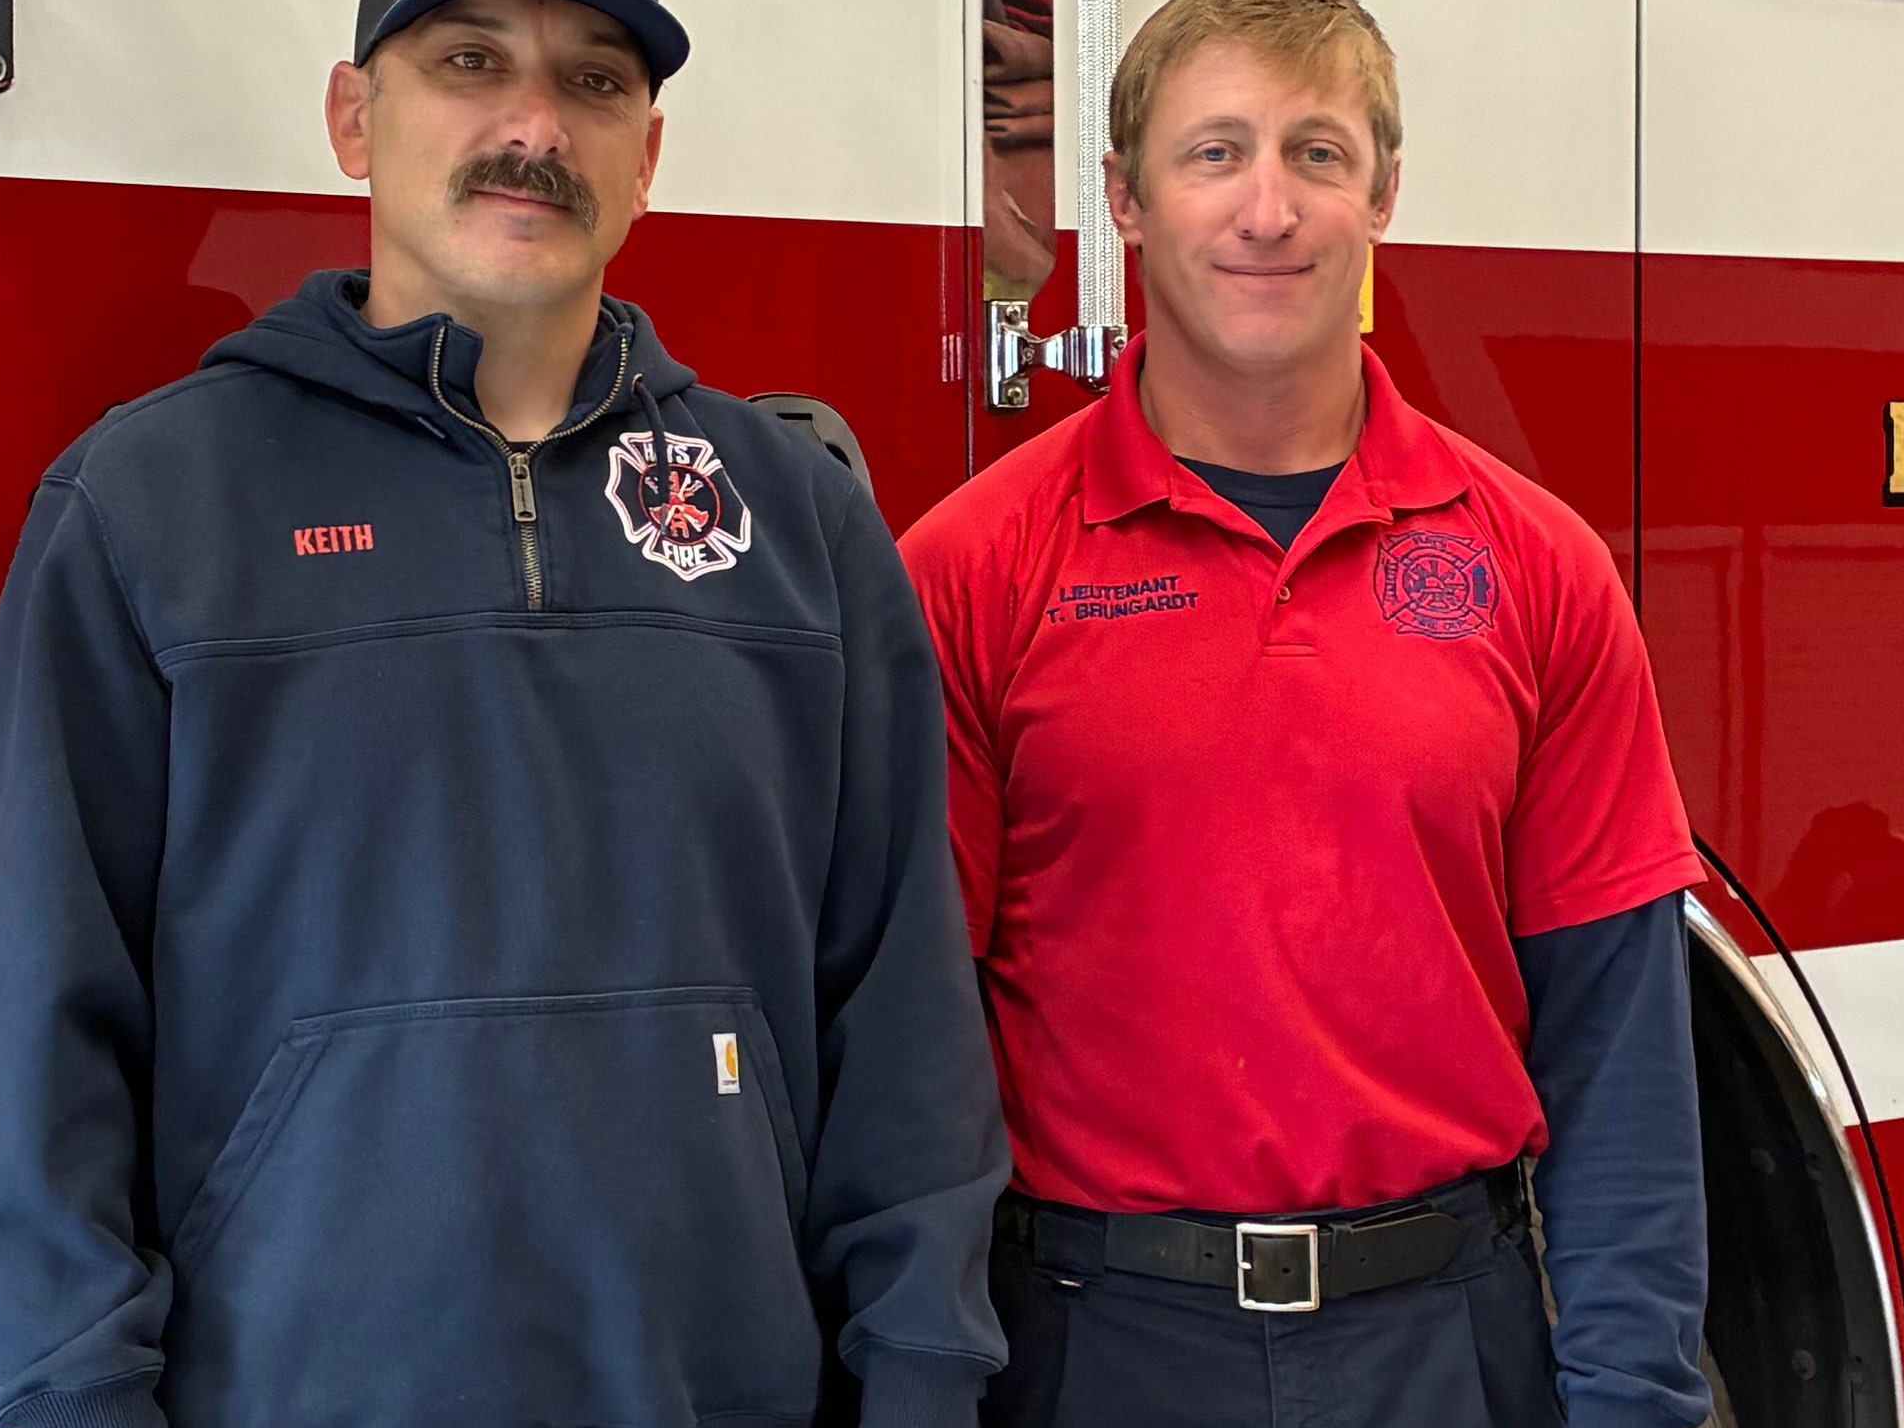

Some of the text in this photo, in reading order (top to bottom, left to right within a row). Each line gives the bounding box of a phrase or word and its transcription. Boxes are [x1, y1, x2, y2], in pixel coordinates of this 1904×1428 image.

[643, 442, 692, 465] HS
[294, 523, 374, 557] KEITH
[661, 539, 708, 569] FIRE
[1059, 573, 1183, 604] LIEUTENANT
[1045, 591, 1200, 624] T. BRUNGARDT
